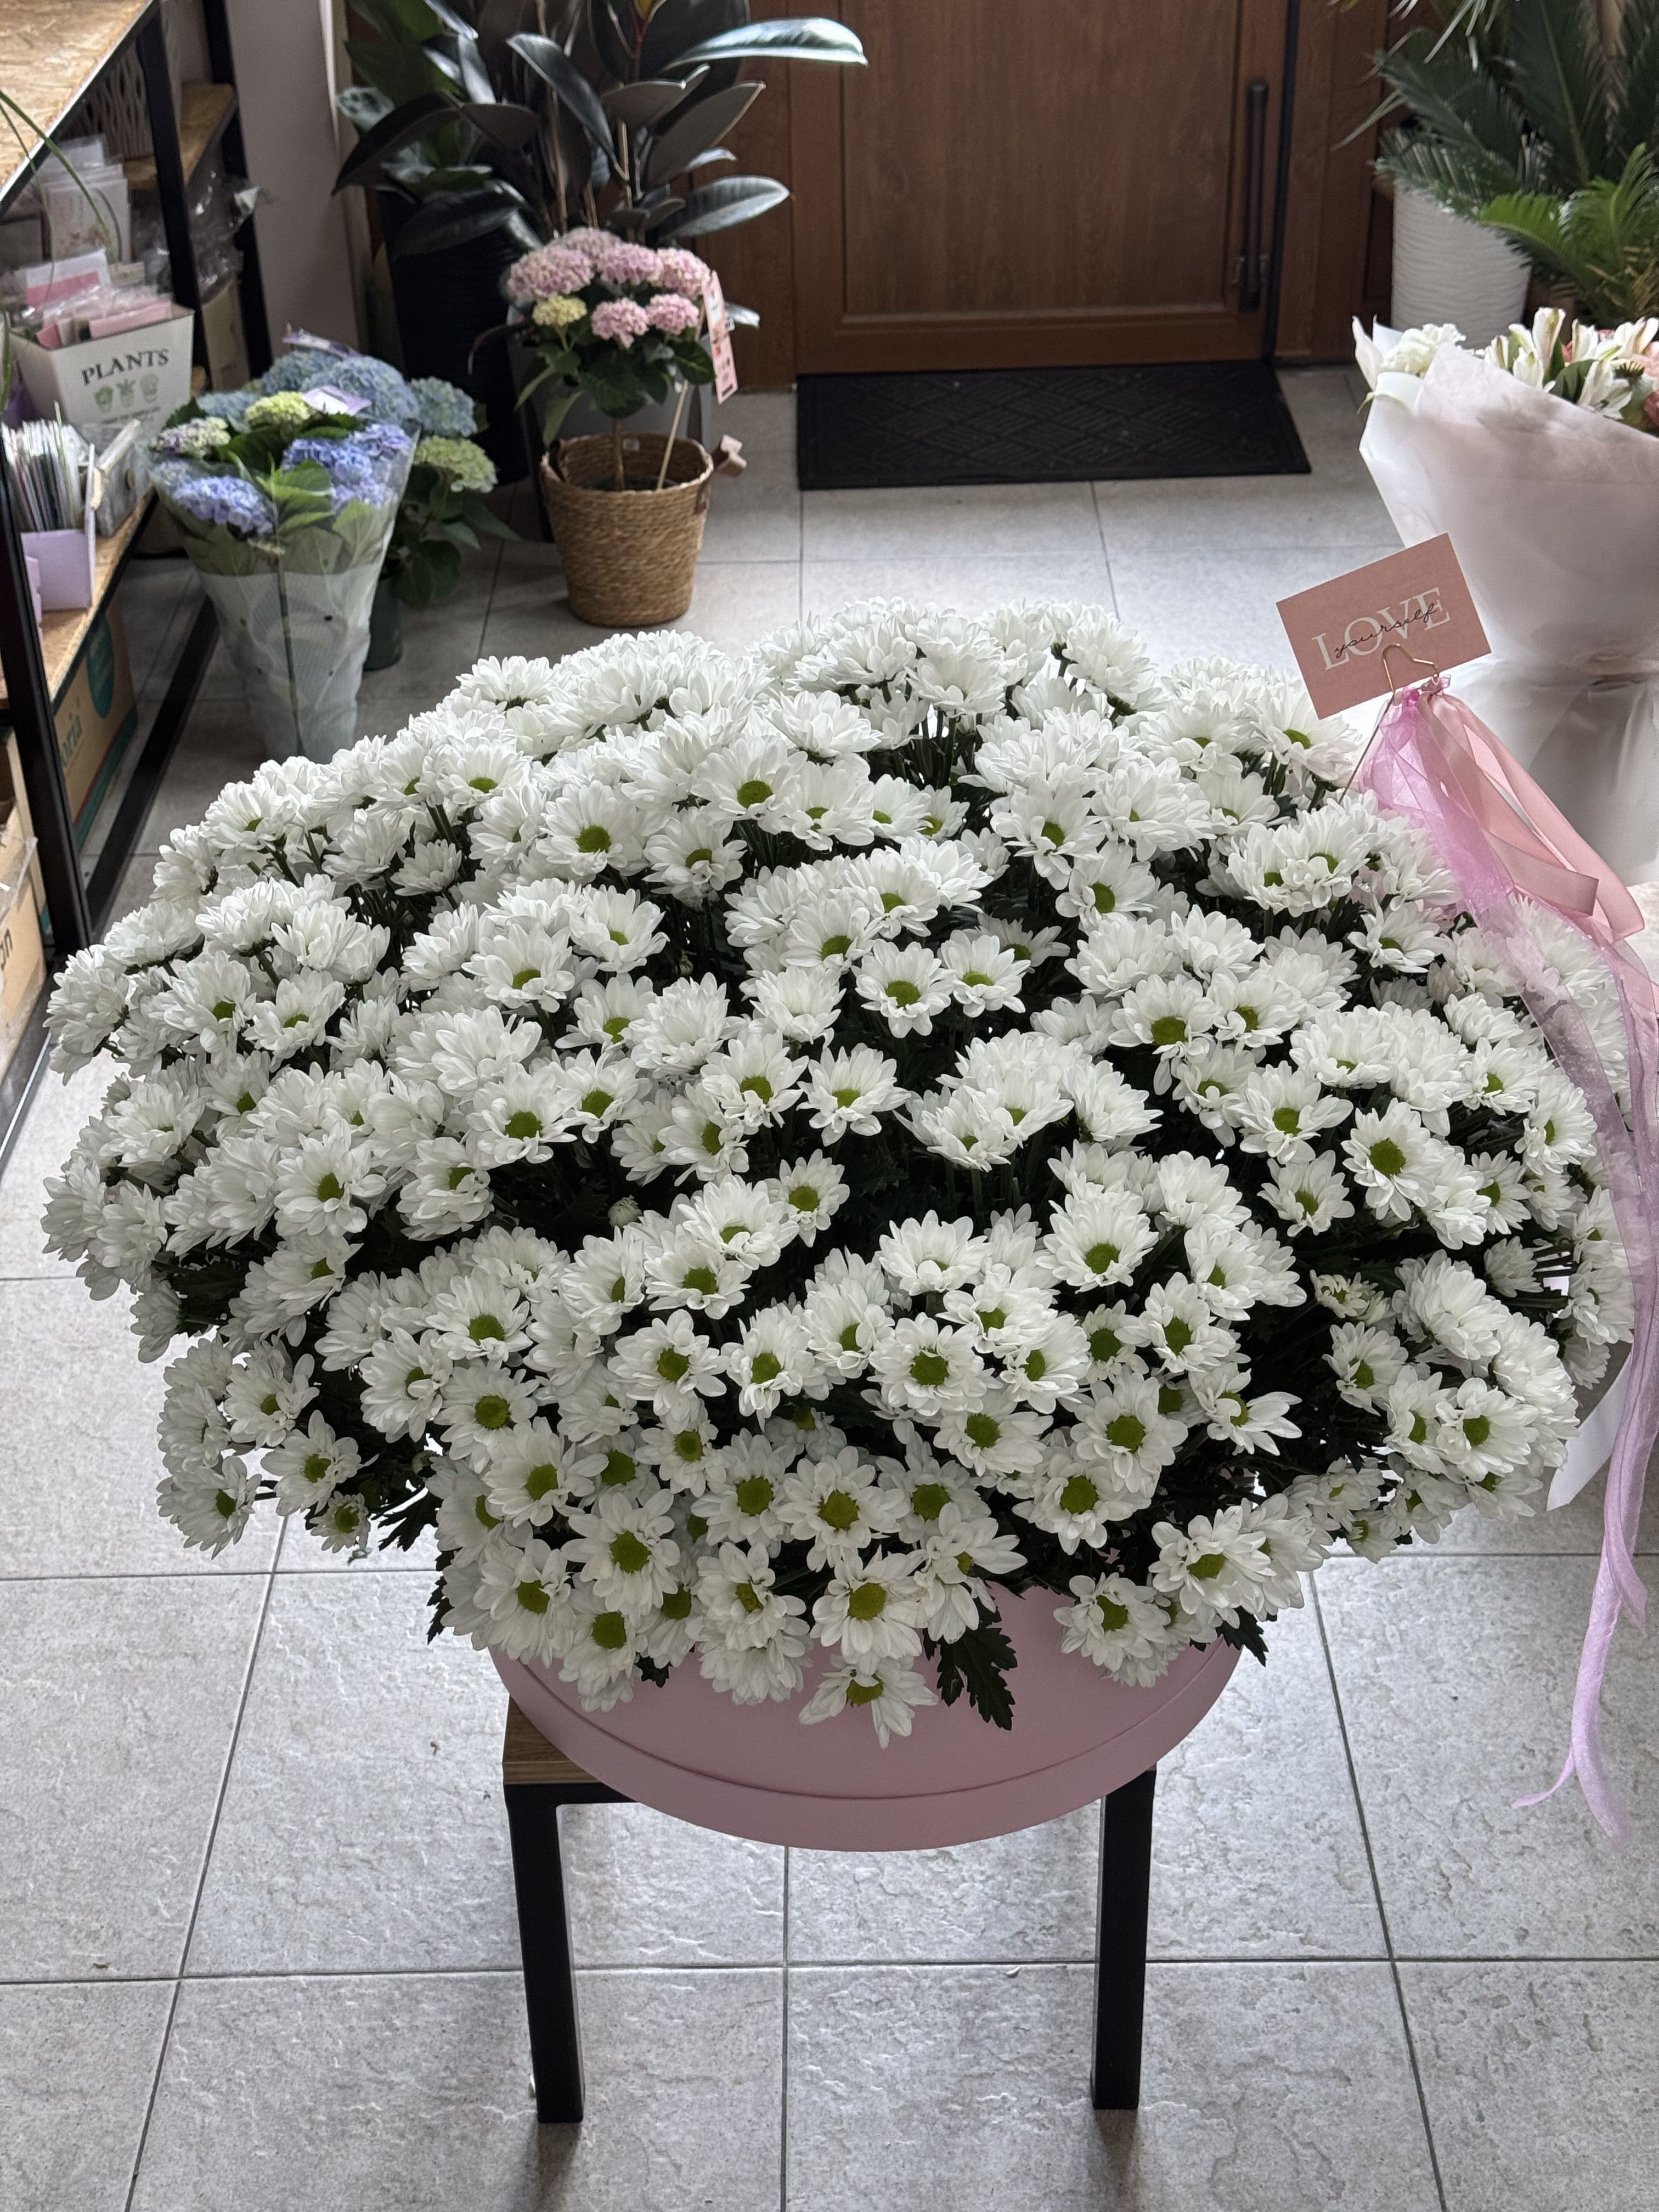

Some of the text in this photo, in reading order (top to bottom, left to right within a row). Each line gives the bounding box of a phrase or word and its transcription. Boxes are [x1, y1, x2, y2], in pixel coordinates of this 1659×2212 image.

[82, 348, 169, 386] PLANTS
[1311, 587, 1451, 670] LOVE
[1334, 602, 1437, 659] yourself
